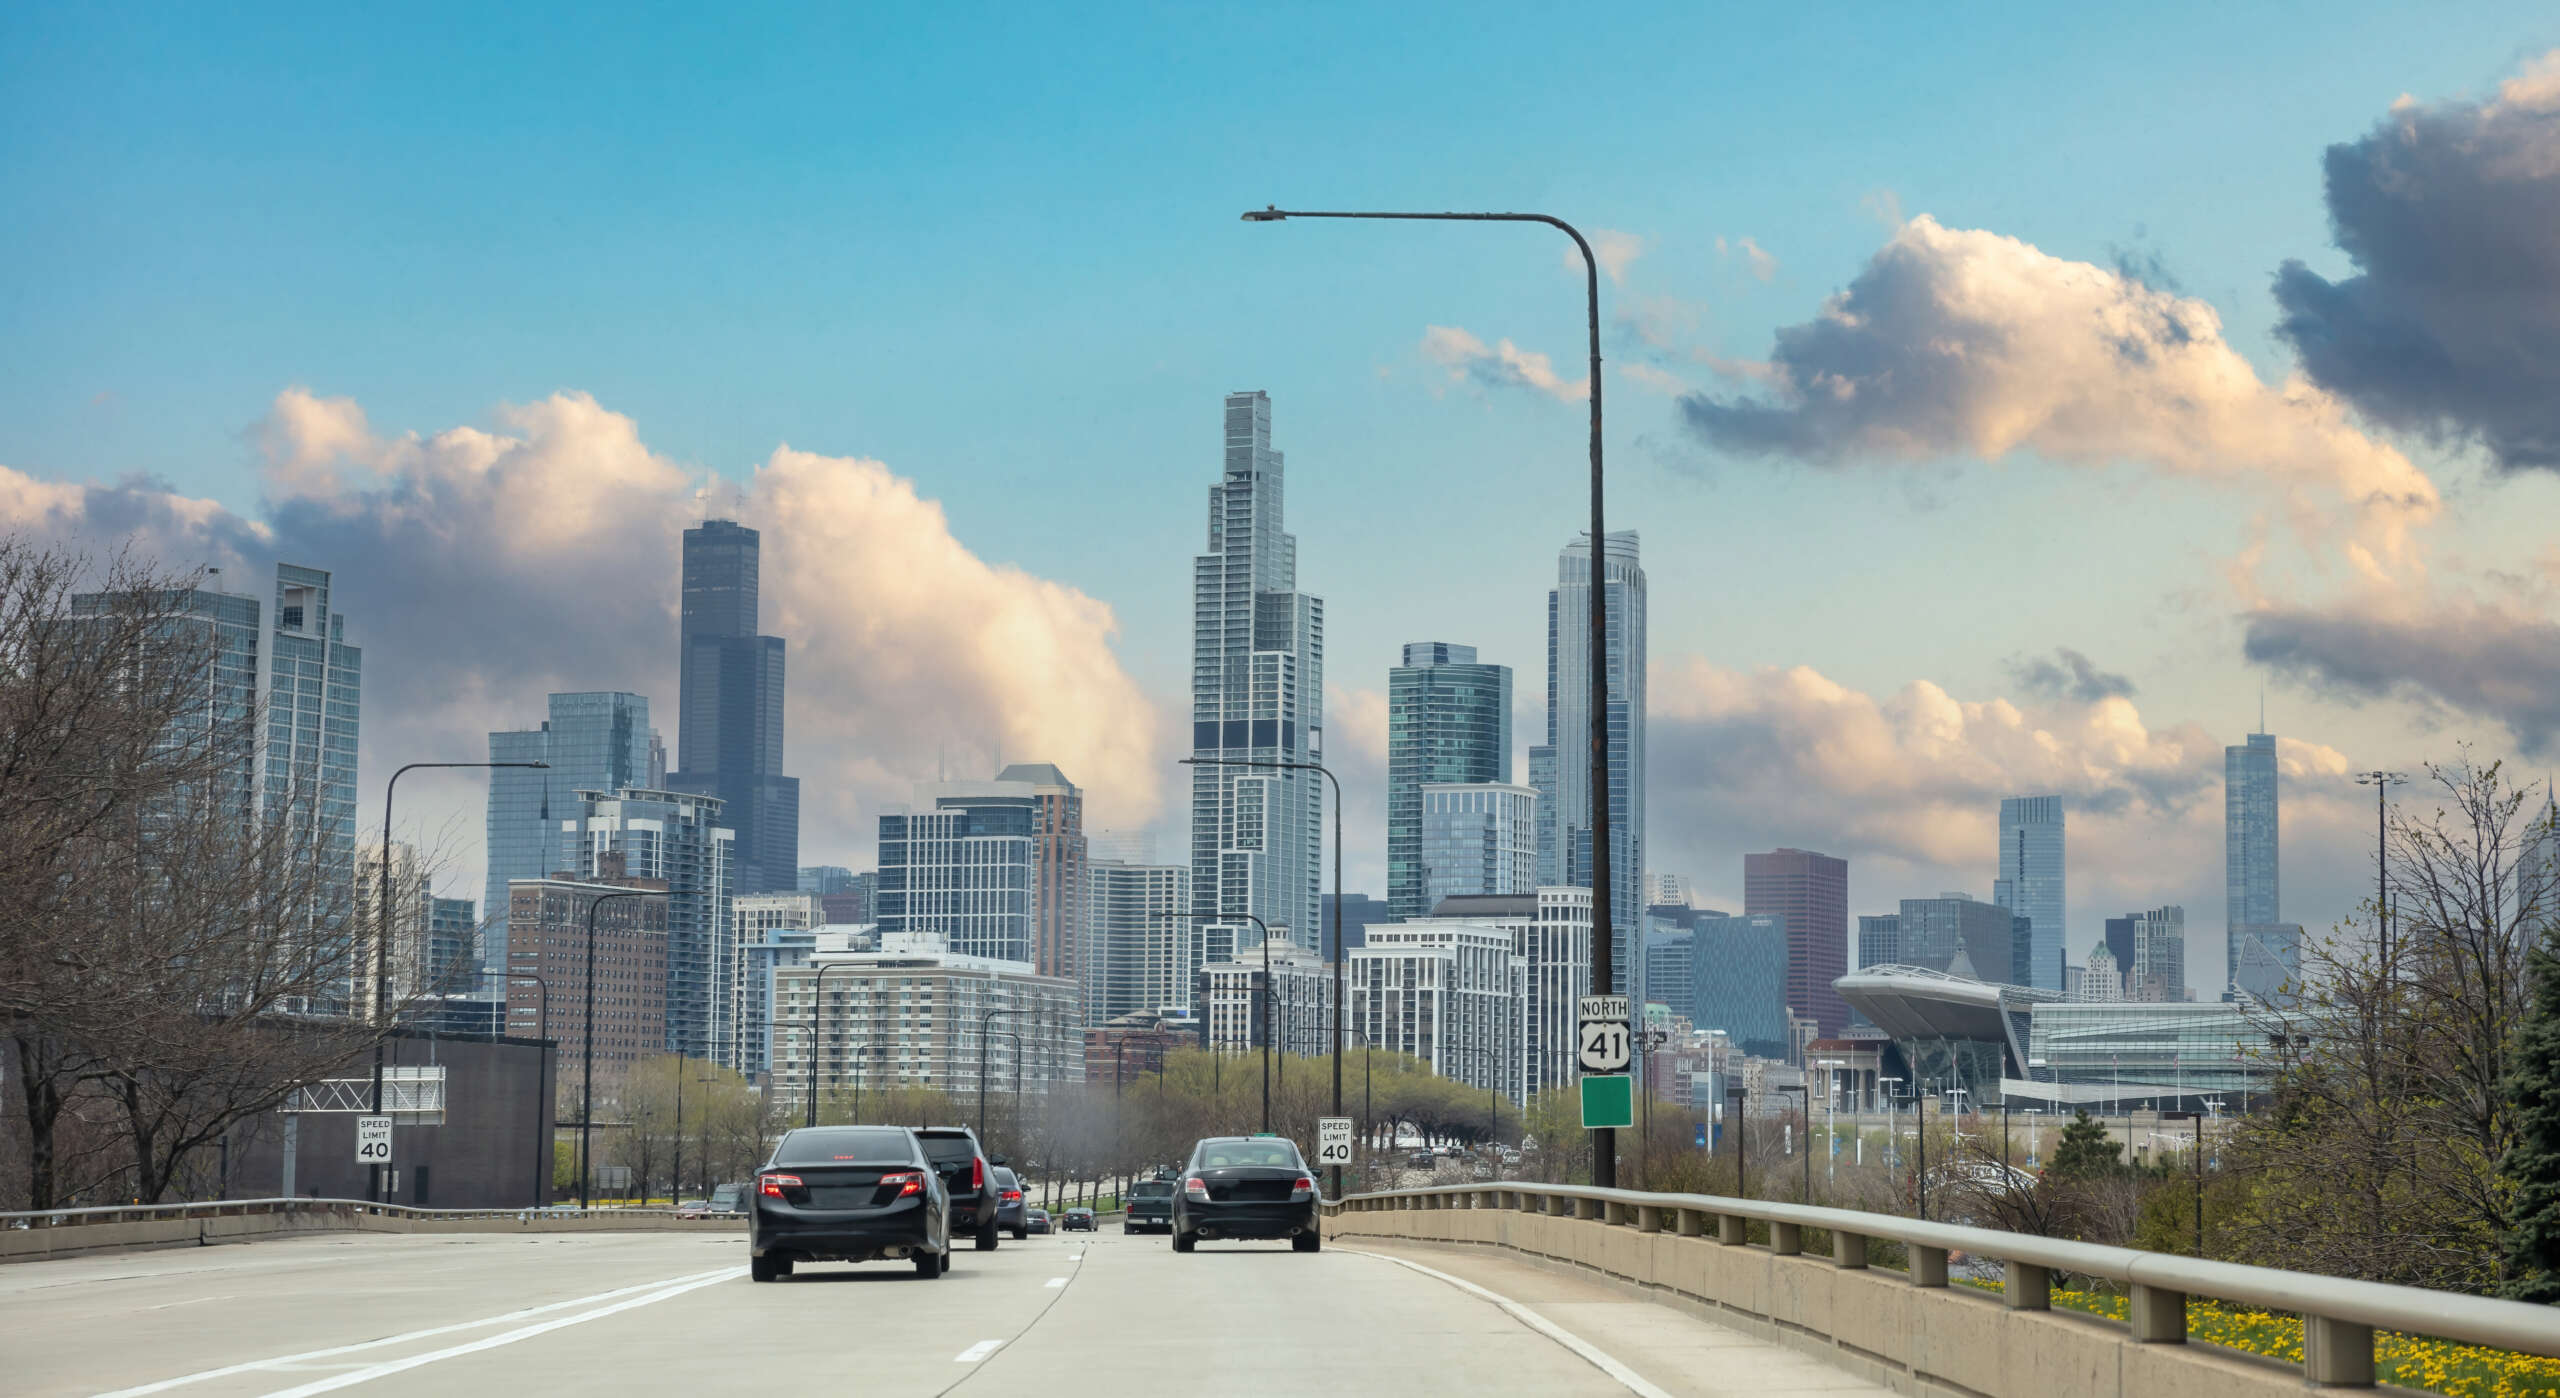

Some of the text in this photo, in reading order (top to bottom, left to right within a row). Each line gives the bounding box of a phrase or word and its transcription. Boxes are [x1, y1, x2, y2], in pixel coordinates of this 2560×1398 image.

[1582, 1001, 1627, 1016] NORTH
[1587, 1032, 1621, 1060] 41
[360, 1120, 391, 1128] SPEED
[1321, 1122, 1350, 1130] SPEED
[362, 1131, 387, 1139] LIMIT
[1323, 1133, 1347, 1141] LIMIT
[360, 1142, 389, 1158] 40
[1322, 1144, 1349, 1160] 40
